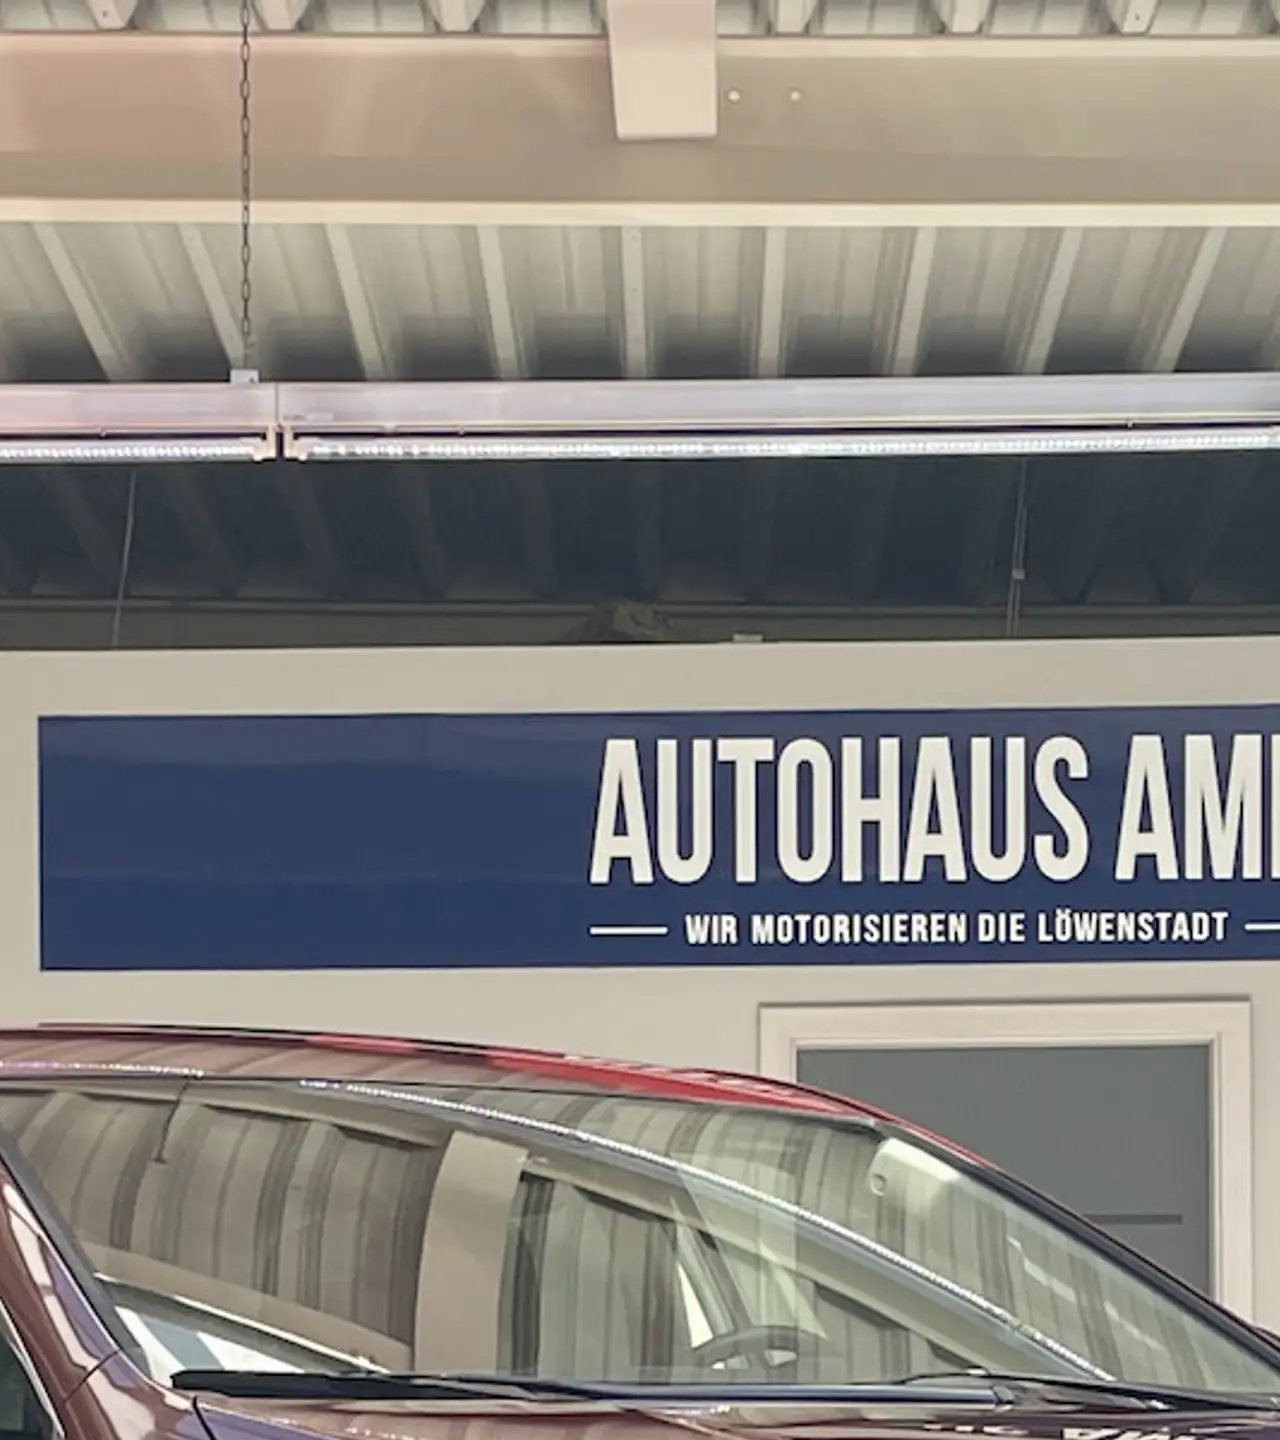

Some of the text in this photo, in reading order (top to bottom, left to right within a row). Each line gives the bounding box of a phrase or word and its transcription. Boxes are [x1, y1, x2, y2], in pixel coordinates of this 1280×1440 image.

[590, 737, 1089, 884] AUTOHAUS
[685, 907, 1229, 944] WIR MOTORISIEREN DIE LÖWENSTADT
